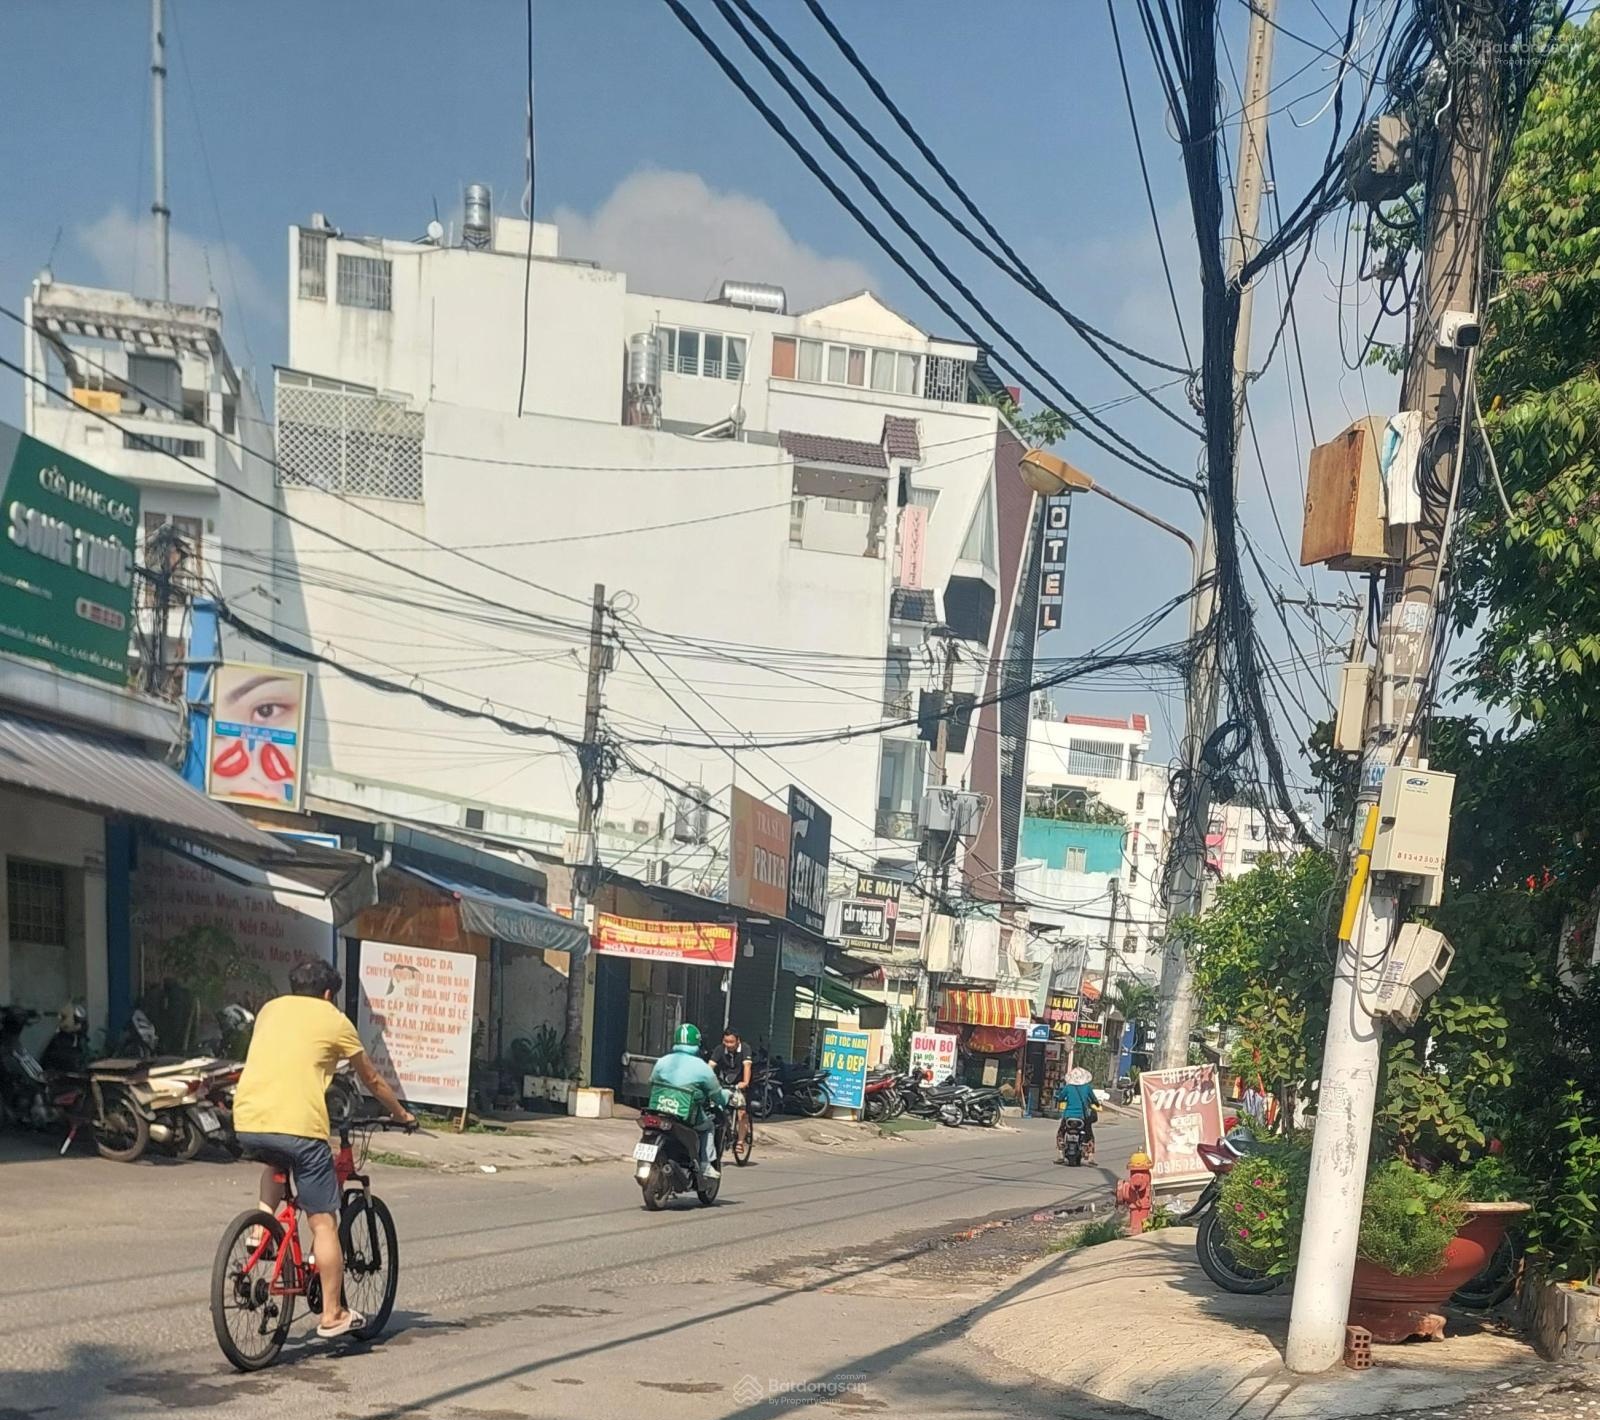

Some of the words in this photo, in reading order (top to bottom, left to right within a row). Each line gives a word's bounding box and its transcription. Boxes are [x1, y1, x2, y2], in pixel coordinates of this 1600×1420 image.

[107, 499, 133, 527] GAS
[8, 501, 73, 567] SONG
[1043, 490, 1067, 627] OTEL
[858, 878, 874, 893] XE
[875, 880, 900, 898] MÁY
[868, 909, 882, 924] NAM
[239, 919, 257, 936] Nốt
[260, 920, 285, 938] Ruồi
[383, 952, 413, 965] CHĂM
[416, 955, 436, 969] SÓC
[439, 959, 454, 971] DA
[426, 974, 435, 985] DA
[387, 998, 404, 1014] CẤP
[406, 1000, 418, 1014] MỸ
[422, 1002, 446, 1018] PHẨM
[1052, 998, 1061, 1008] XE
[1062, 998, 1078, 1009] MÁY
[397, 1015, 417, 1030] XĂM
[1053, 1020, 1071, 1035] 40
[839, 1036, 852, 1048] TÓC
[852, 1037, 868, 1049] NAM
[915, 1036, 936, 1051] BÚN
[939, 1037, 953, 1053] BÒ
[823, 1049, 836, 1068] KỸ
[837, 1053, 845, 1070] &
[846, 1055, 865, 1075] ĐẸP
[658, 1095, 679, 1108] Grab
